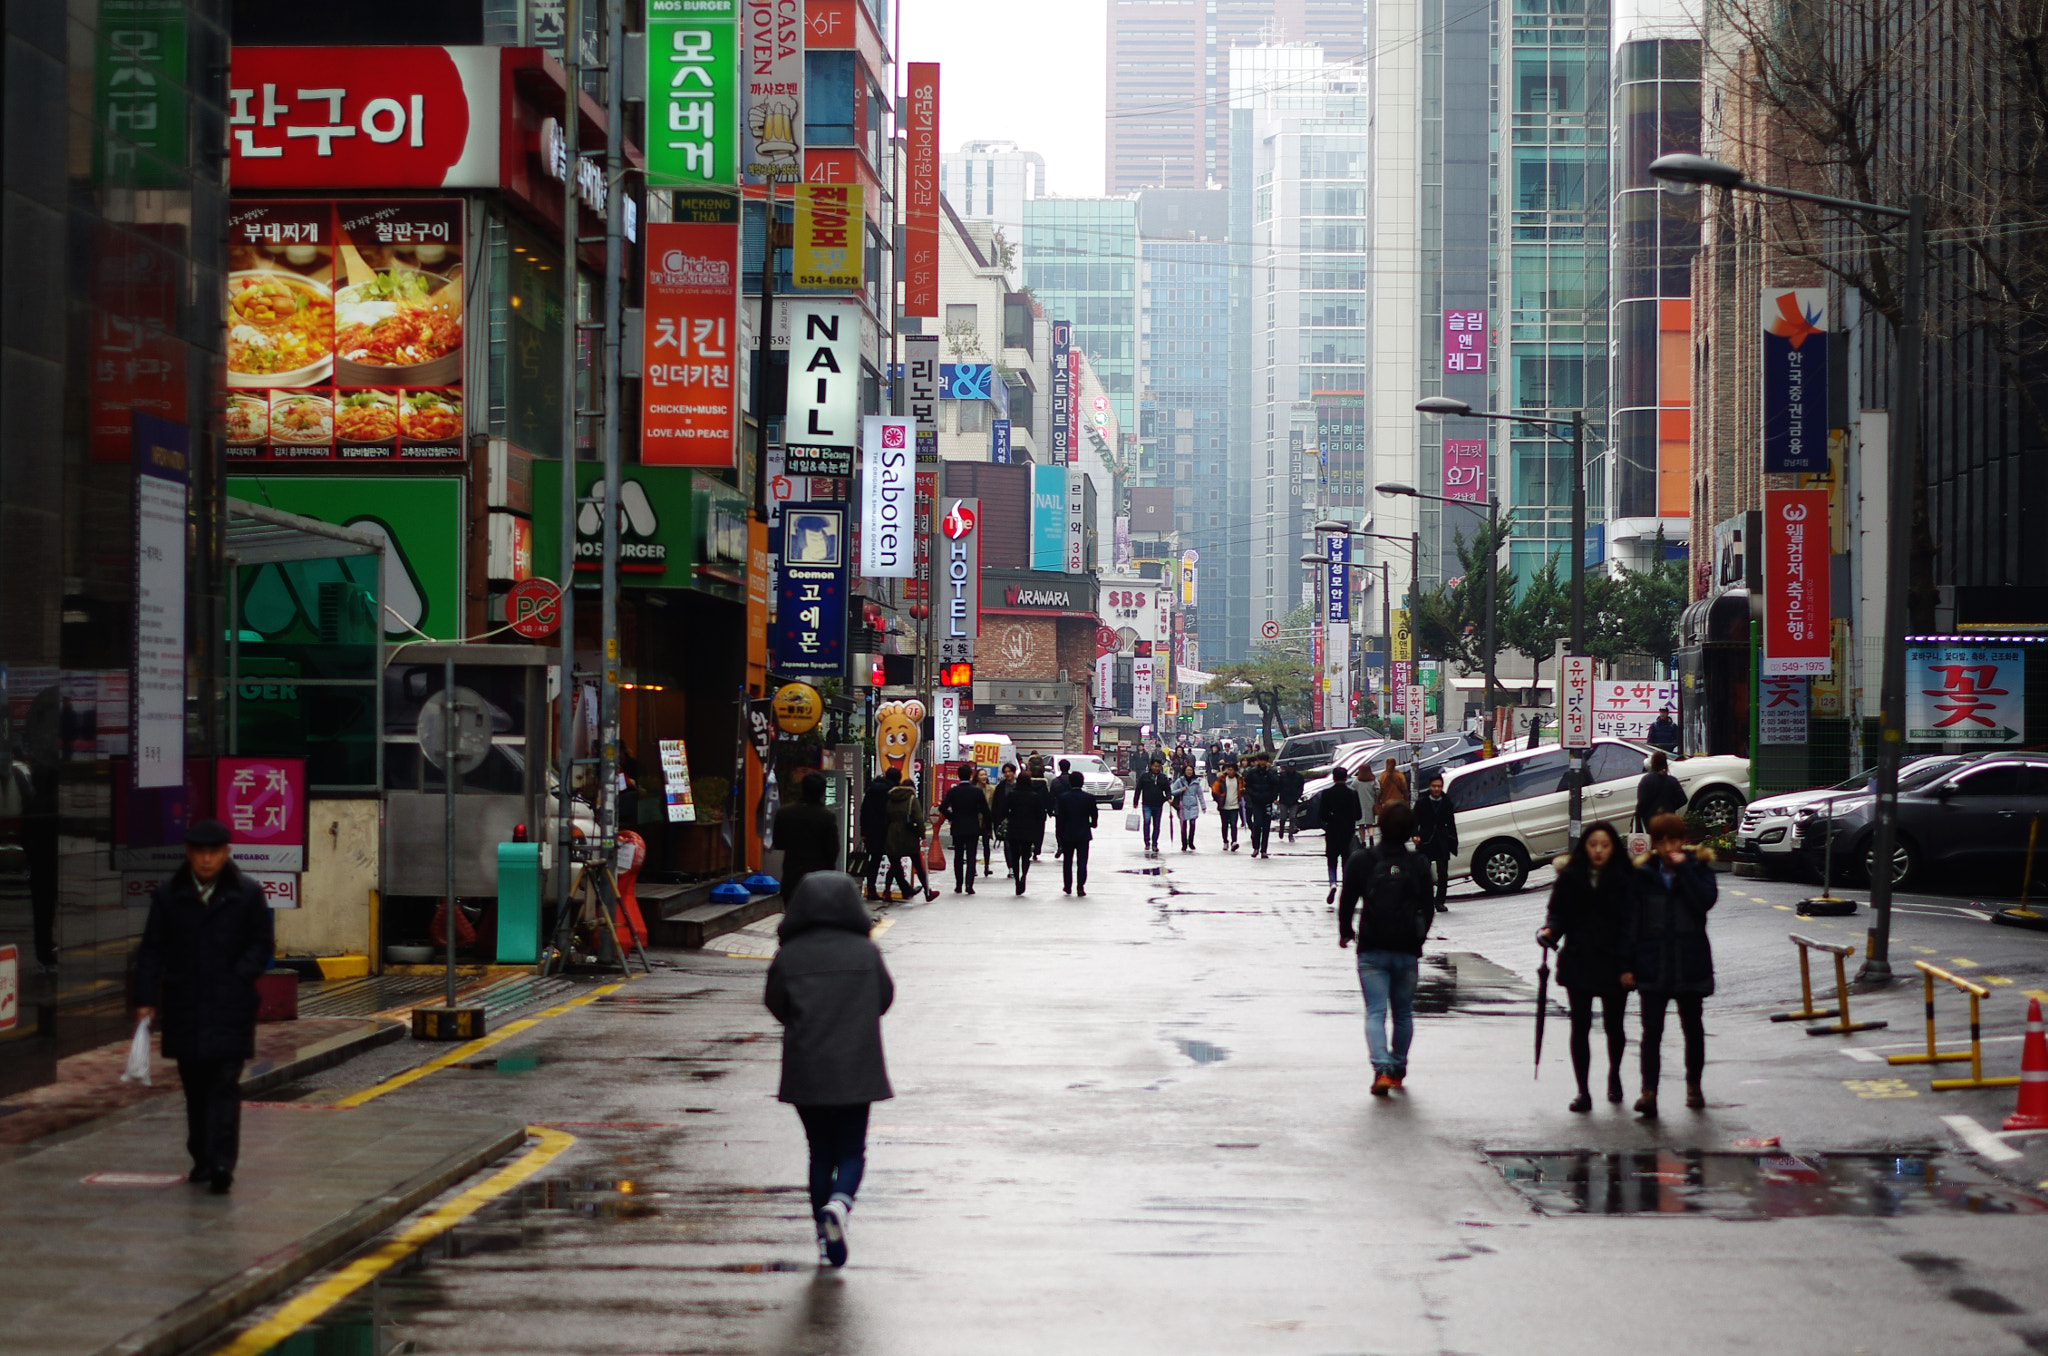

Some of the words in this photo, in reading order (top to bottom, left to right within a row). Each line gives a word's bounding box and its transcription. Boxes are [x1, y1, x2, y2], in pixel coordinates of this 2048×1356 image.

[653, 1, 682, 11] MOS
[684, 1, 731, 11] BURGER
[778, 0, 796, 60] CASA
[813, 11, 841, 35] 6F
[750, 83, 798, 95] 까사호벤
[668, 30, 714, 179] 모스버거
[810, 162, 840, 184] 4F
[681, 199, 731, 209] MEKONG
[691, 211, 720, 221] THAI
[244, 222, 319, 243] 부대찌개
[375, 221, 449, 242] 철판구이
[663, 249, 729, 274] Chicken
[914, 251, 930, 263] 6F
[914, 272, 930, 284] 5F
[913, 293, 930, 305] 4F
[1448, 312, 1483, 331] 슬림
[654, 317, 725, 357] 치킨
[1458, 334, 1473, 350] 앤
[1448, 353, 1482, 371] 레그
[649, 364, 729, 387] 인더키친
[806, 314, 841, 435] NAIL
[1054, 354, 1068, 426] 월스트리트
[1787, 351, 1803, 455] 한국증권금융
[647, 429, 673, 437] LOVE
[675, 429, 695, 438] AND
[697, 429, 729, 438] PEACE
[821, 448, 850, 462] Beauty
[1449, 443, 1482, 463] 시크릿
[1783, 459, 1809, 467] 강남지점
[788, 460, 849, 474] 네일&속눈썹
[1446, 465, 1484, 491] 요가
[881, 452, 905, 567] Saboten
[1036, 494, 1063, 510] NAIL
[1071, 485, 1082, 534] 르브와
[621, 544, 666, 558] URGER
[1071, 542, 1081, 569] 3층
[789, 569, 834, 580] Goemon
[1331, 538, 1343, 612] 강남성모안과
[1785, 523, 1804, 641] 웰컴저축은행
[950, 542, 967, 637] HOTEL
[1005, 584, 1070, 607] WARAWARA
[1108, 591, 1146, 607] SBS
[517, 596, 555, 624] PC
[798, 584, 821, 653] 고에몬
[1160, 606, 1168, 633] 노래방
[1568, 660, 1588, 733] 유학닷컴
[1922, 665, 2009, 728] 꽃
[908, 707, 919, 717] 7F
[942, 709, 954, 759] Saboten
[1598, 722, 1644, 737] 박문각
[974, 744, 998, 765] 임대
[233, 769, 288, 795] 주차
[232, 804, 287, 831] 금지
[233, 853, 271, 861] MEGABOX
